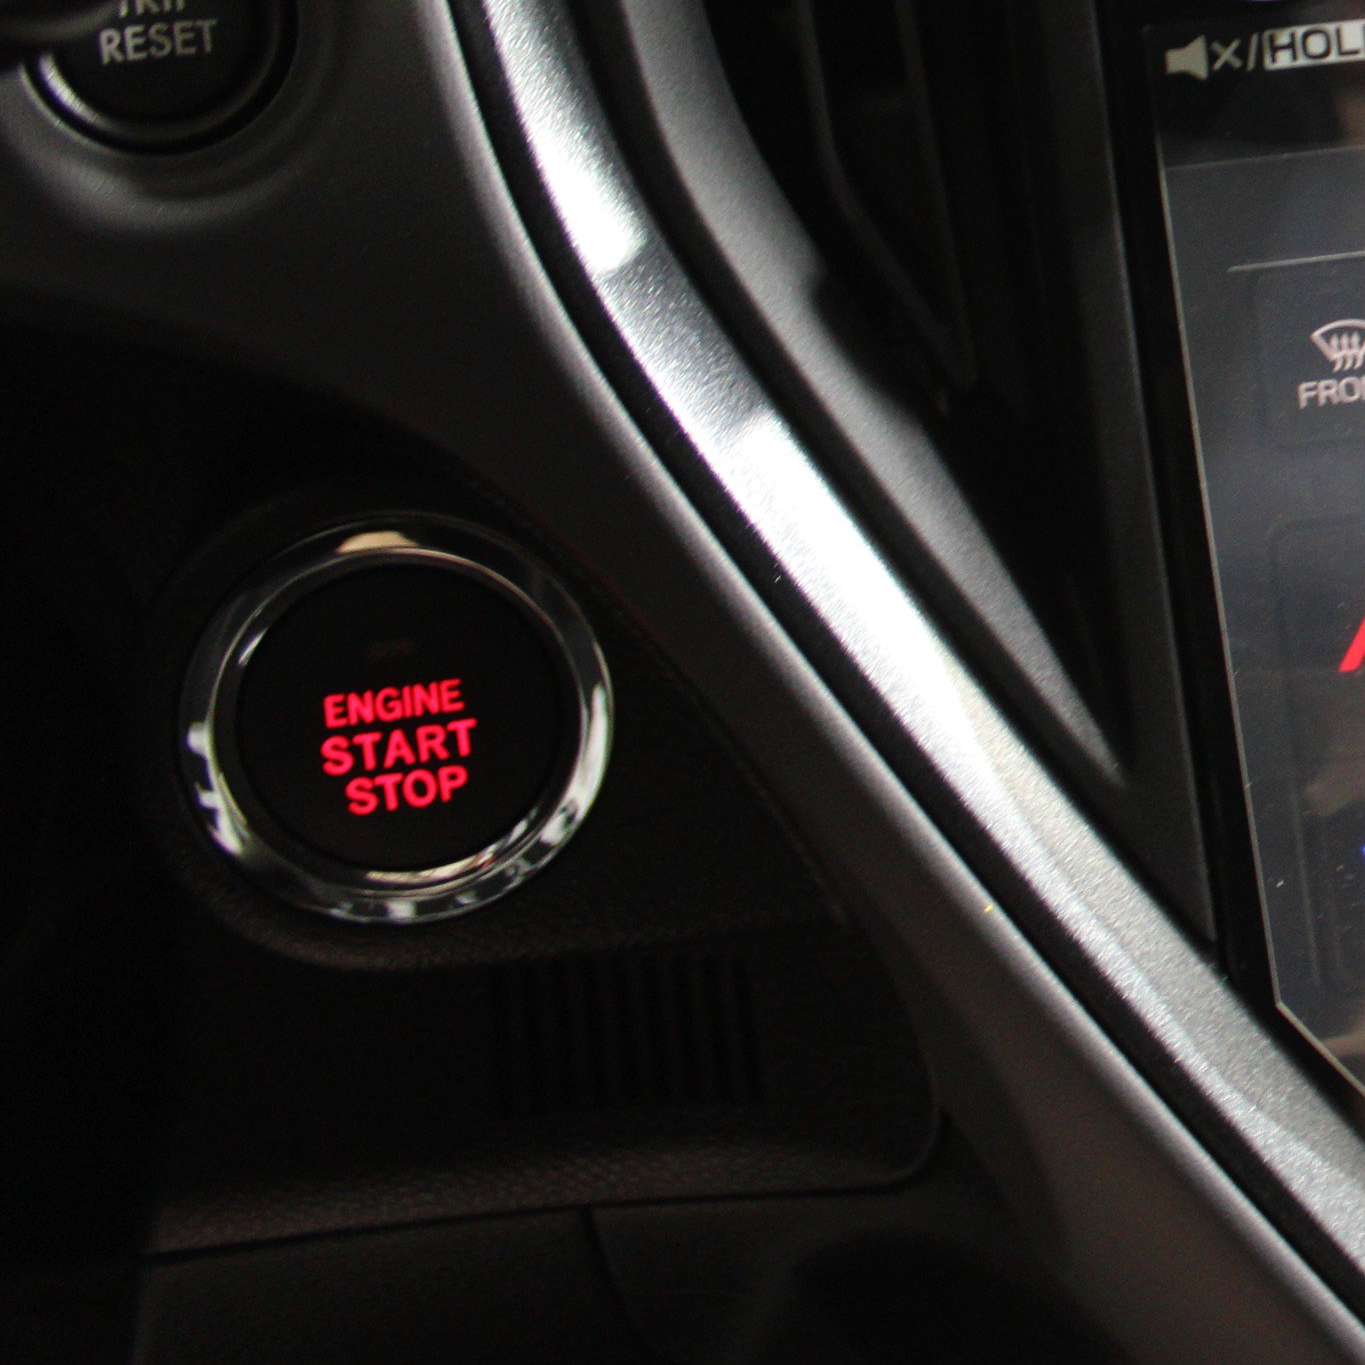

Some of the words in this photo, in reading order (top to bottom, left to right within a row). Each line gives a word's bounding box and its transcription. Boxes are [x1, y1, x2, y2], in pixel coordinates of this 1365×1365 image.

[100, 19, 217, 66] RESET
[323, 678, 465, 728] ENGINE
[321, 719, 478, 776] START
[345, 766, 469, 815] STOP
